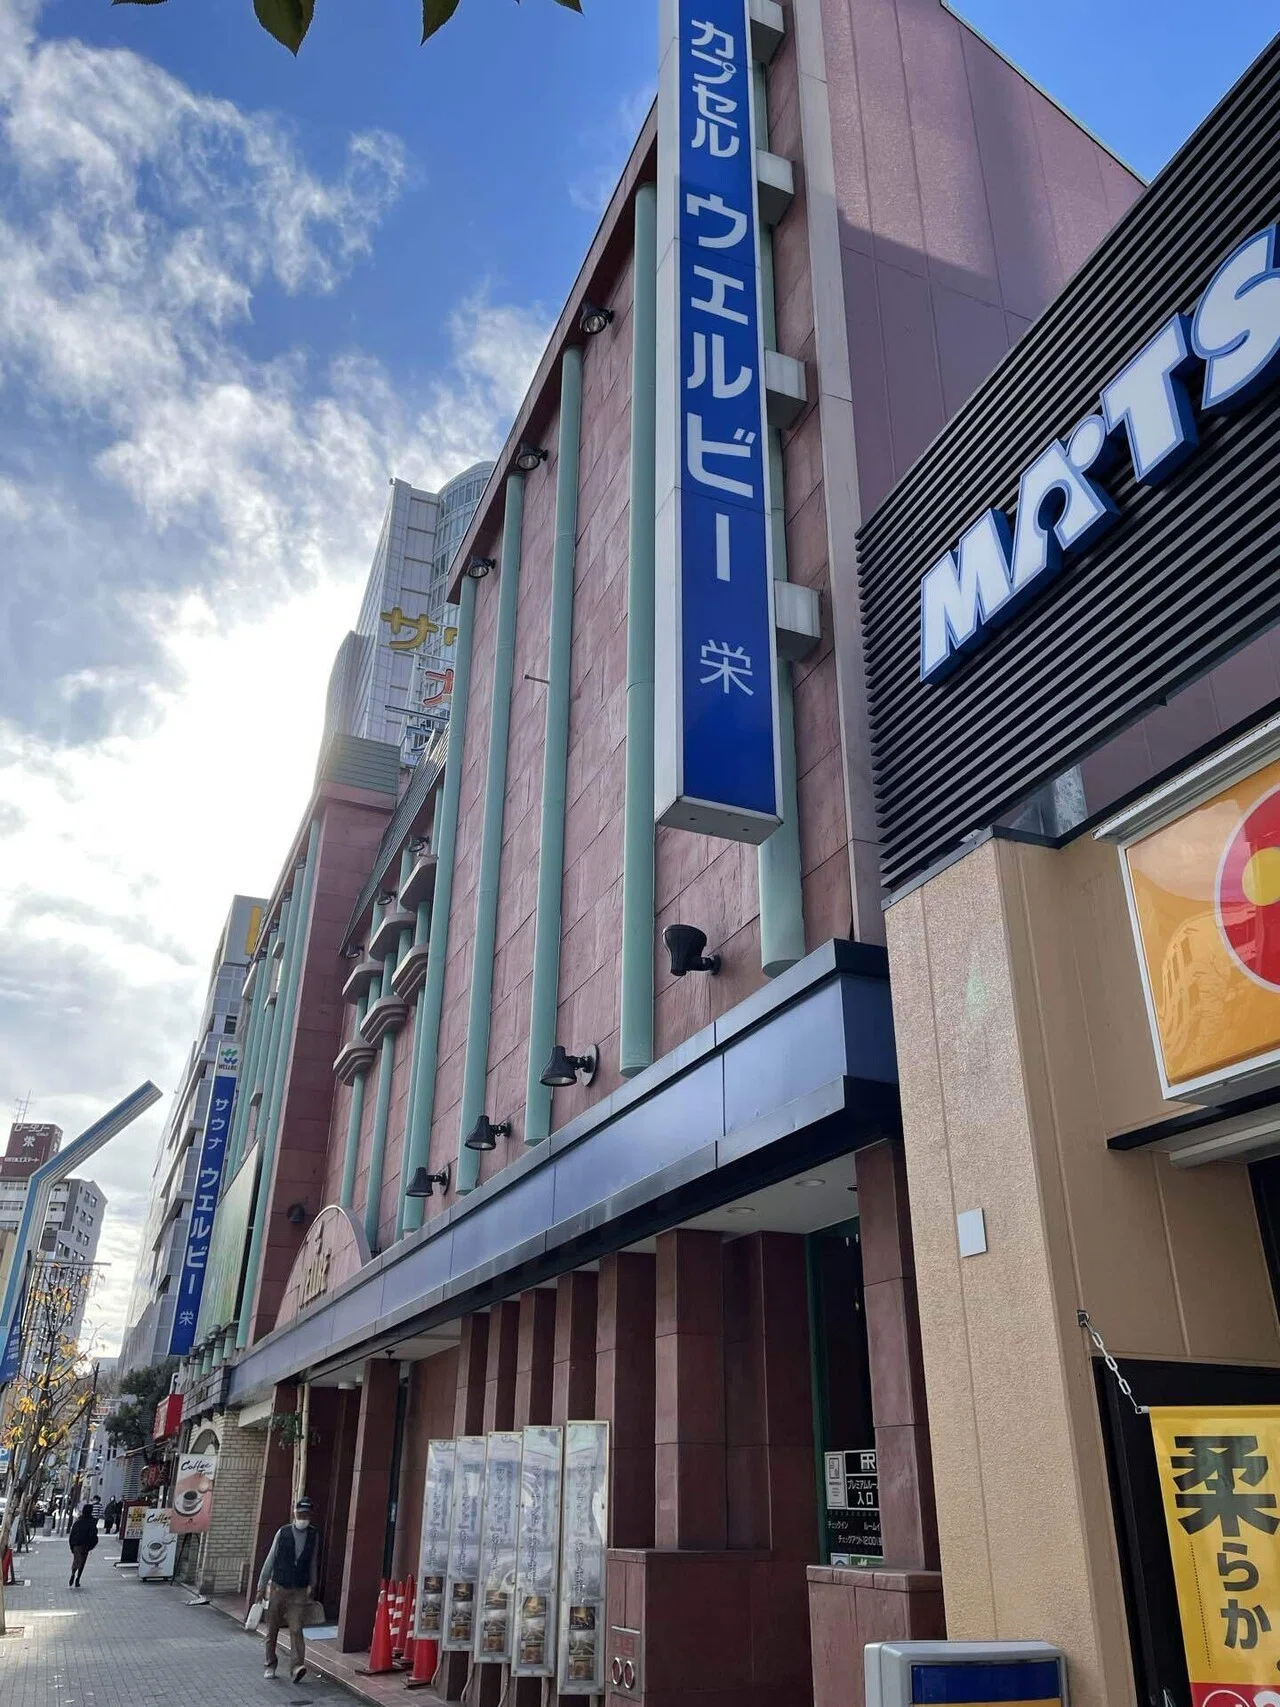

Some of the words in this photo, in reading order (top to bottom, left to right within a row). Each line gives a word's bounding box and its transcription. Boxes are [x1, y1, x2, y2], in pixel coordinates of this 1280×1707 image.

[691, 19, 740, 158] カプセル
[700, 639, 754, 697] 栄
[23, 1135, 35, 1147] 栄
[208, 1098, 229, 1150] サウナ
[178, 1310, 194, 1326] 栄
[847, 1479, 879, 1490] プレミアムルー
[857, 1491, 874, 1505] 入口
[1171, 1435, 1280, 1650] 柔らか
